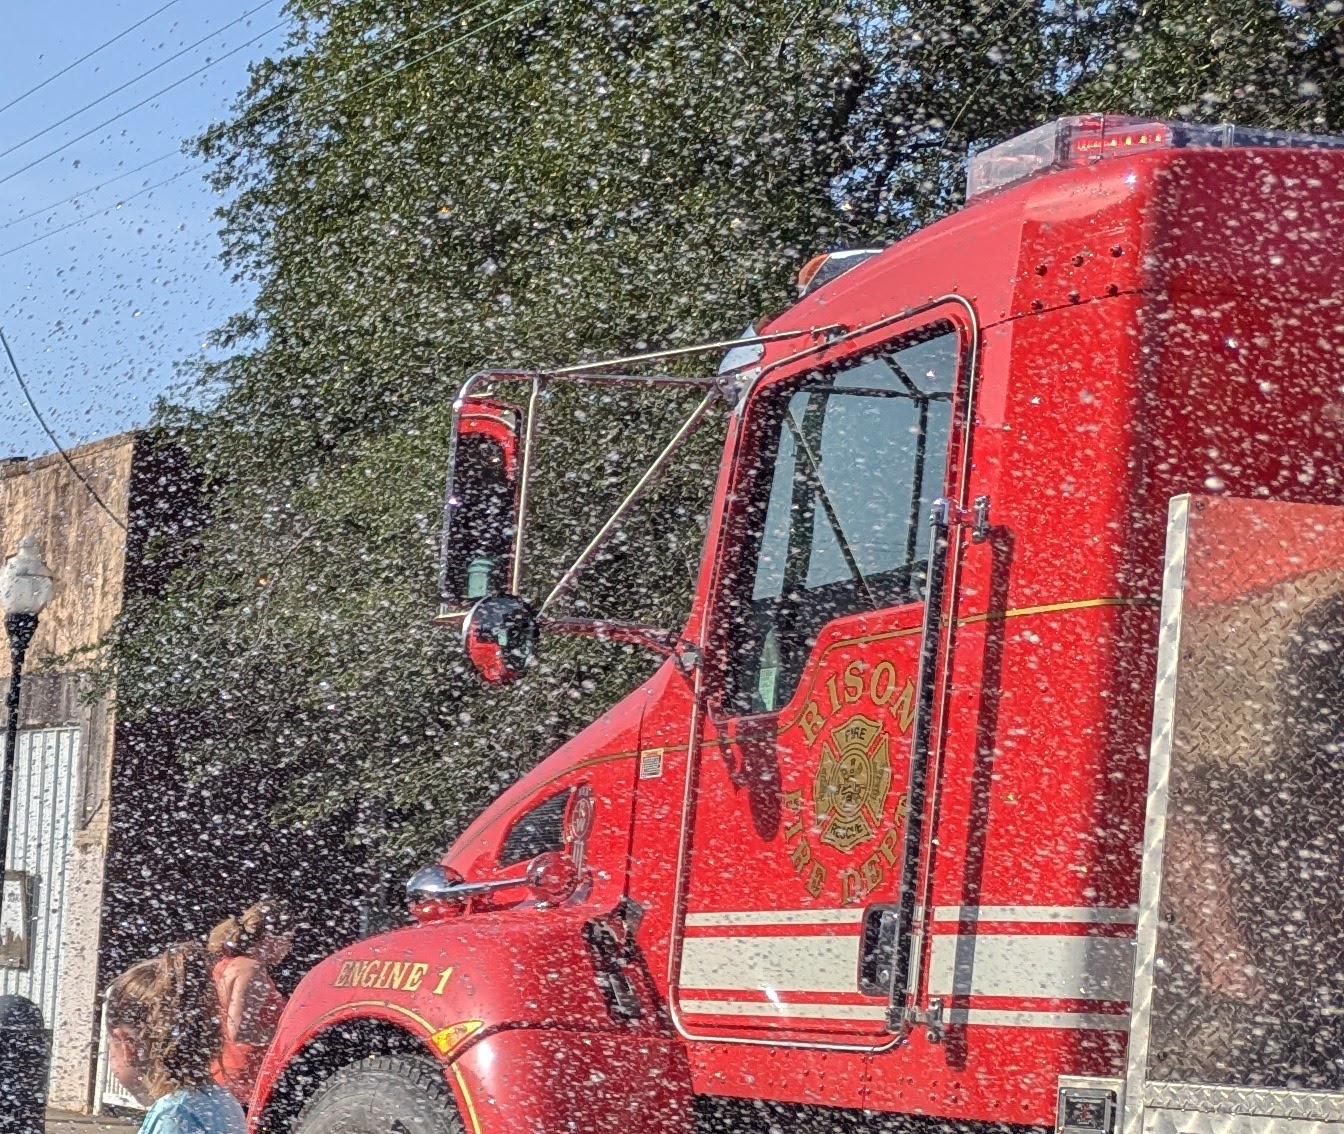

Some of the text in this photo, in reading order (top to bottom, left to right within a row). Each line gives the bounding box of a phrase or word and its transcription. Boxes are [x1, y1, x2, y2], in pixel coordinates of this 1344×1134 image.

[798, 659, 915, 746] RISON
[844, 727, 867, 741] FIRE
[782, 790, 828, 898] FIRE
[334, 960, 455, 995] ENGINE 1
